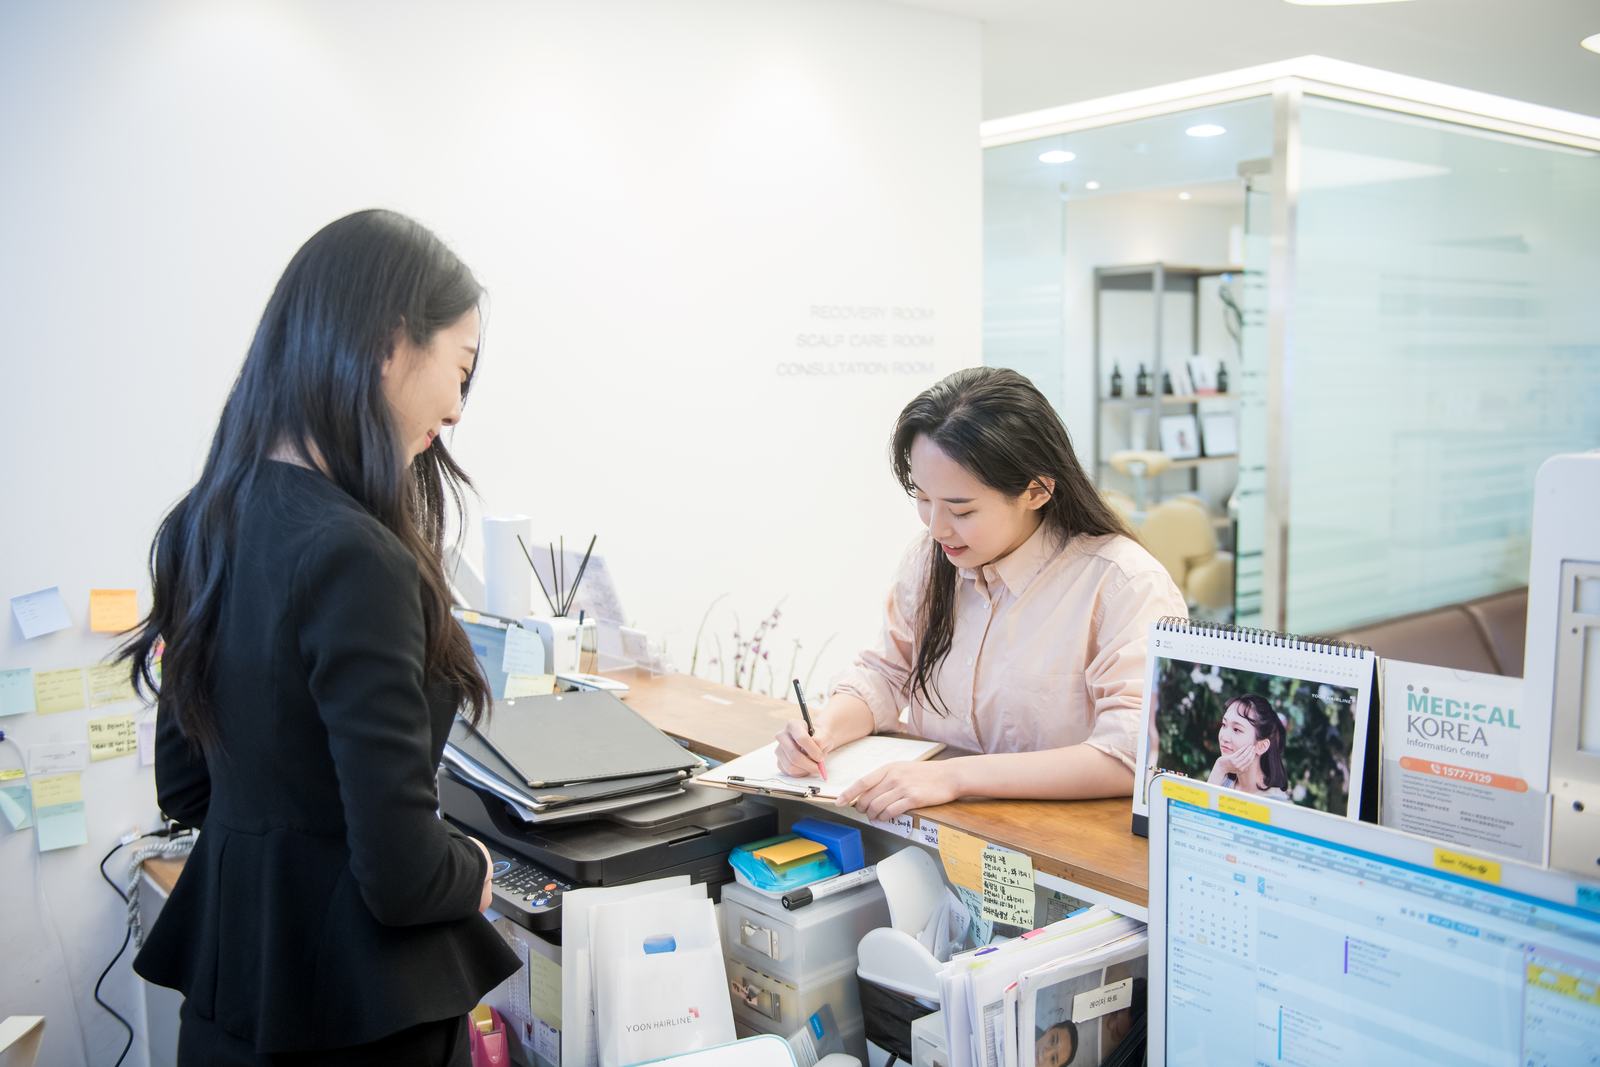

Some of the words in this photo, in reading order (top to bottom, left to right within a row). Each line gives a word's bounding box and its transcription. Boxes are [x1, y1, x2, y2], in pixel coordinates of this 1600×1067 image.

[810, 305, 887, 320] RECOVERY
[892, 305, 935, 320] ROOM
[796, 334, 845, 348] SCALP
[849, 334, 888, 348] CARE
[892, 333, 935, 348] ROOM
[776, 361, 889, 376] CONSULTATION
[892, 361, 935, 376] ROOM
[1155, 639, 1161, 648] 3
[1407, 691, 1521, 730] MEDICAL
[1407, 714, 1488, 746] KOREA
[1407, 737, 1458, 754] Information
[1460, 747, 1490, 760] Center
[1442, 766, 1492, 784] 1577-7129
[625, 1023, 652, 1033] YOON
[654, 1016, 692, 1029] HAIRLINE
